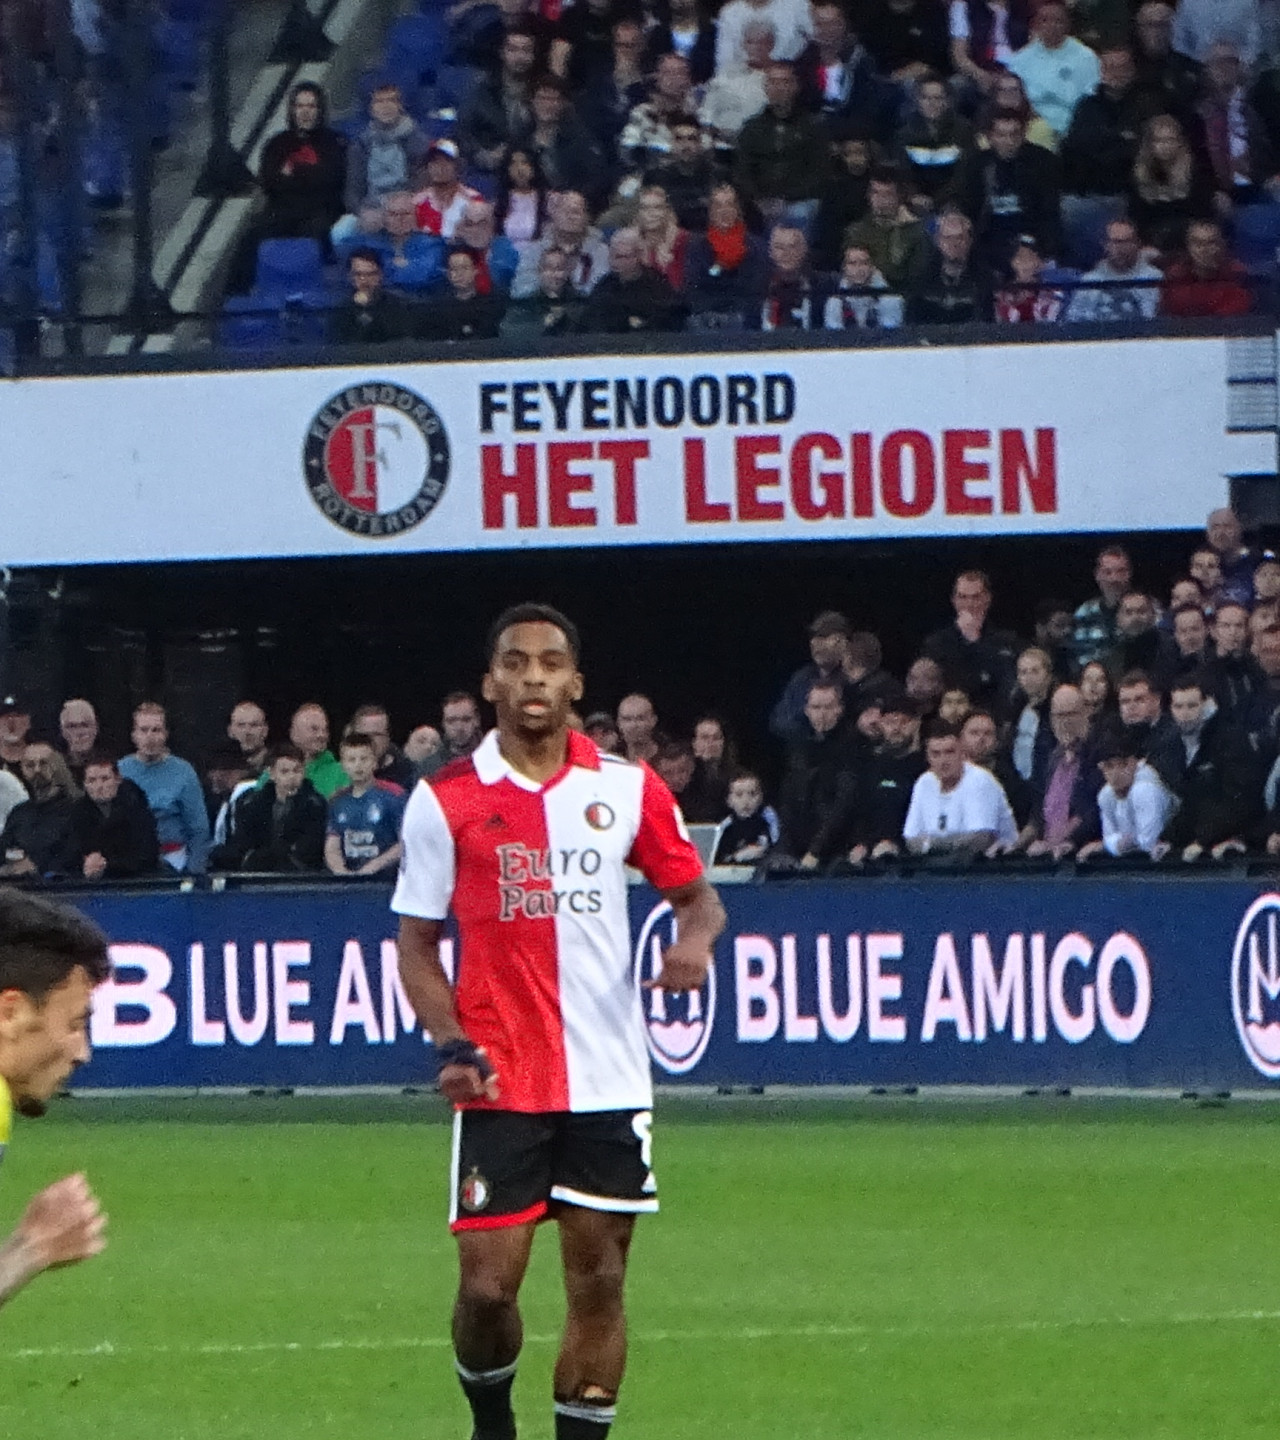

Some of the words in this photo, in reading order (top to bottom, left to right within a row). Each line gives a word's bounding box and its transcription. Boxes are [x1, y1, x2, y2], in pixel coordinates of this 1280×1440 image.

[479, 373, 796, 433] FEYENOORD
[480, 438, 651, 530] HET
[682, 427, 1059, 524] LEGIOEN
[495, 842, 602, 884] Euro
[499, 884, 603, 922] Parcs
[89, 940, 315, 1047] BLUE
[734, 932, 907, 1043] BLUE
[920, 931, 1153, 1044] AMIGO
